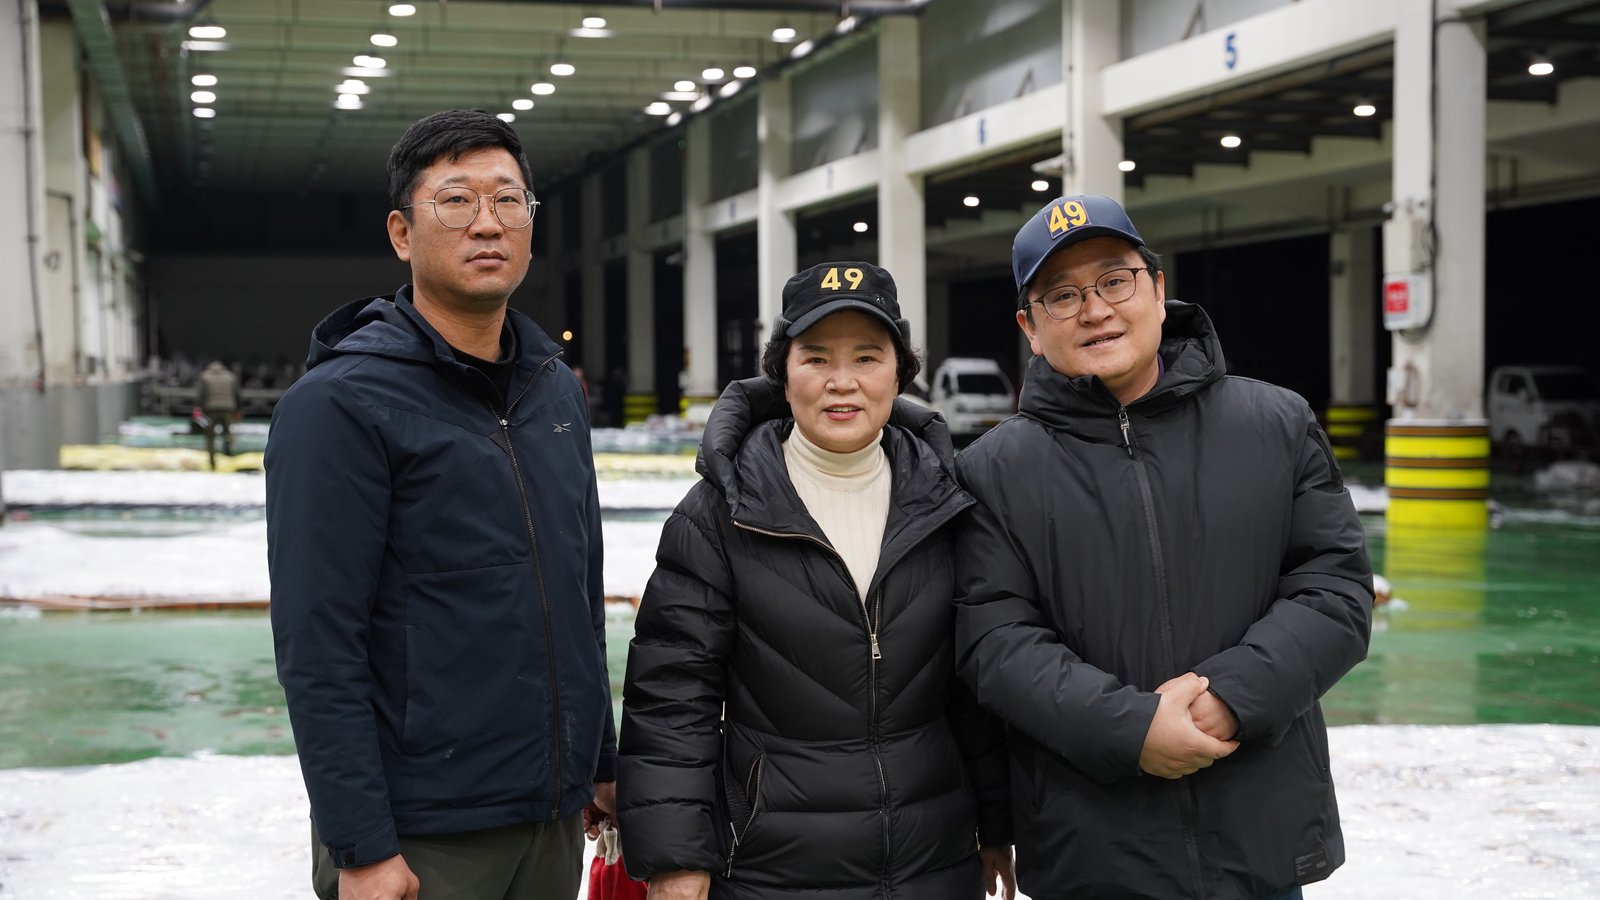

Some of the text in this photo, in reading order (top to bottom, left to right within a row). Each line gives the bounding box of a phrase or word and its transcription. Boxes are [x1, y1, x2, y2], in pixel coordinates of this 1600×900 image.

[1225, 33, 1238, 70] 5
[1049, 201, 1087, 233] 49
[820, 267, 864, 291] 49
